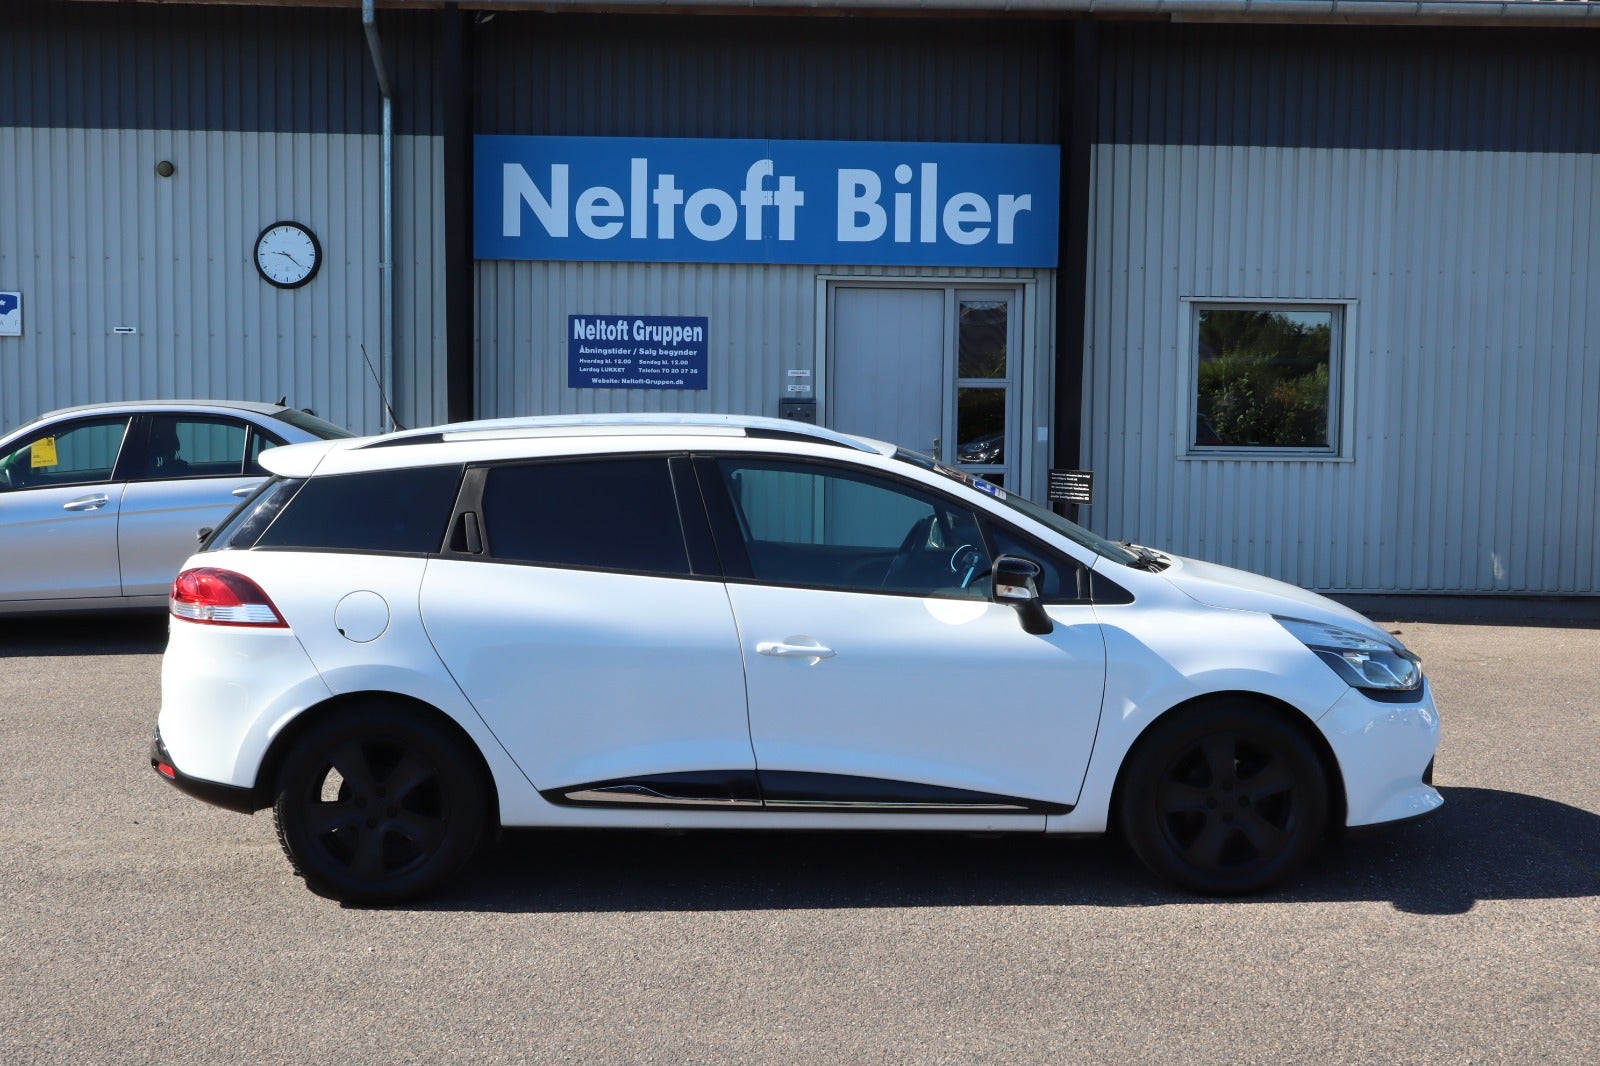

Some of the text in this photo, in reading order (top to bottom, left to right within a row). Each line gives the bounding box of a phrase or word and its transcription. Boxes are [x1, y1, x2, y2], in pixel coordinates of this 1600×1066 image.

[503, 158, 1032, 245] Neltoft Biler
[573, 319, 703, 346] Neltoft Gruppen
[579, 345, 632, 356] Åbningstider
[639, 348, 657, 356] Salg
[658, 348, 698, 357] begynder
